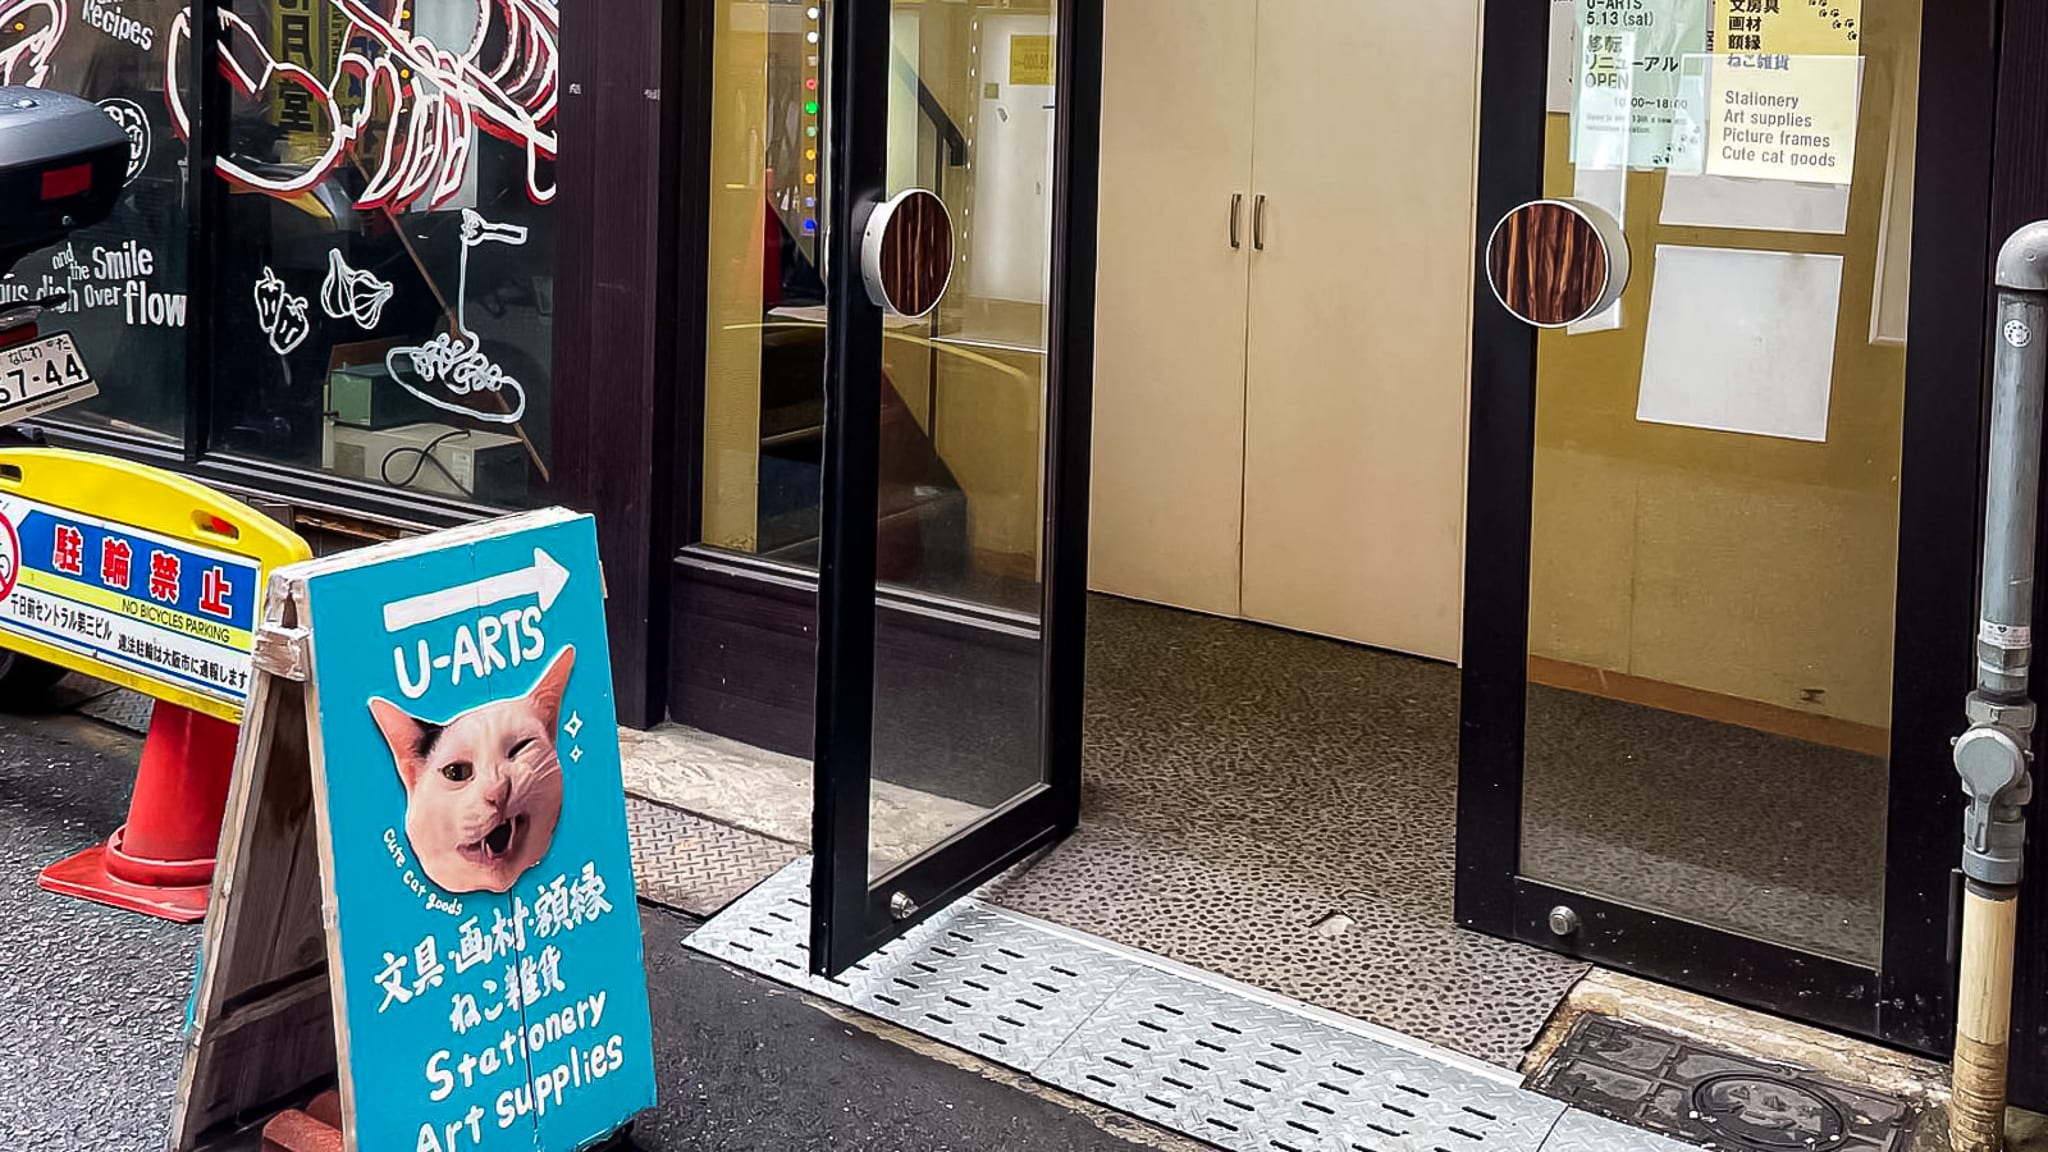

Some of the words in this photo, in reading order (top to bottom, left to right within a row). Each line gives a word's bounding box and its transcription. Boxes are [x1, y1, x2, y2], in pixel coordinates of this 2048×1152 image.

[1729, 0, 1780, 14] 文房具
[82, 0, 153, 50] Recipes
[1586, 11, 1619, 26] 5.13
[1728, 16, 1762, 32] 画材
[1587, 34, 1623, 53] 移転
[1728, 34, 1761, 50] 額縁
[1585, 54, 1679, 72] リニューアル
[1727, 54, 1790, 71] ねこ雑貨
[1585, 73, 1629, 90] OPEN
[1725, 90, 1799, 109] Stationery
[1724, 108, 1745, 124] Art
[1750, 111, 1813, 128] supplies
[1723, 127, 1774, 144] Picture
[1780, 130, 1831, 147] frames
[1722, 145, 1756, 161] Cute
[1761, 150, 1784, 163] cat
[1791, 152, 1836, 168] goods
[52, 241, 75, 269] and
[70, 260, 90, 280] the
[92, 240, 153, 280] Smile
[84, 284, 121, 308] Over
[123, 280, 187, 327] flow
[8, 345, 44, 365] なにわ
[54, 524, 232, 618] 駐輪禁止
[121, 598, 139, 615] NO
[140, 603, 185, 629] BICYCLES
[186, 619, 231, 643] PARKING
[393, 606, 545, 699] U-ARTS
[403, 870, 427, 897] cat
[425, 893, 463, 916] goods
[450, 944, 565, 1034] ねこ雑貨
[425, 991, 606, 1101] Stationery
[416, 1105, 485, 1152] Art
[496, 1035, 624, 1128] supplies
